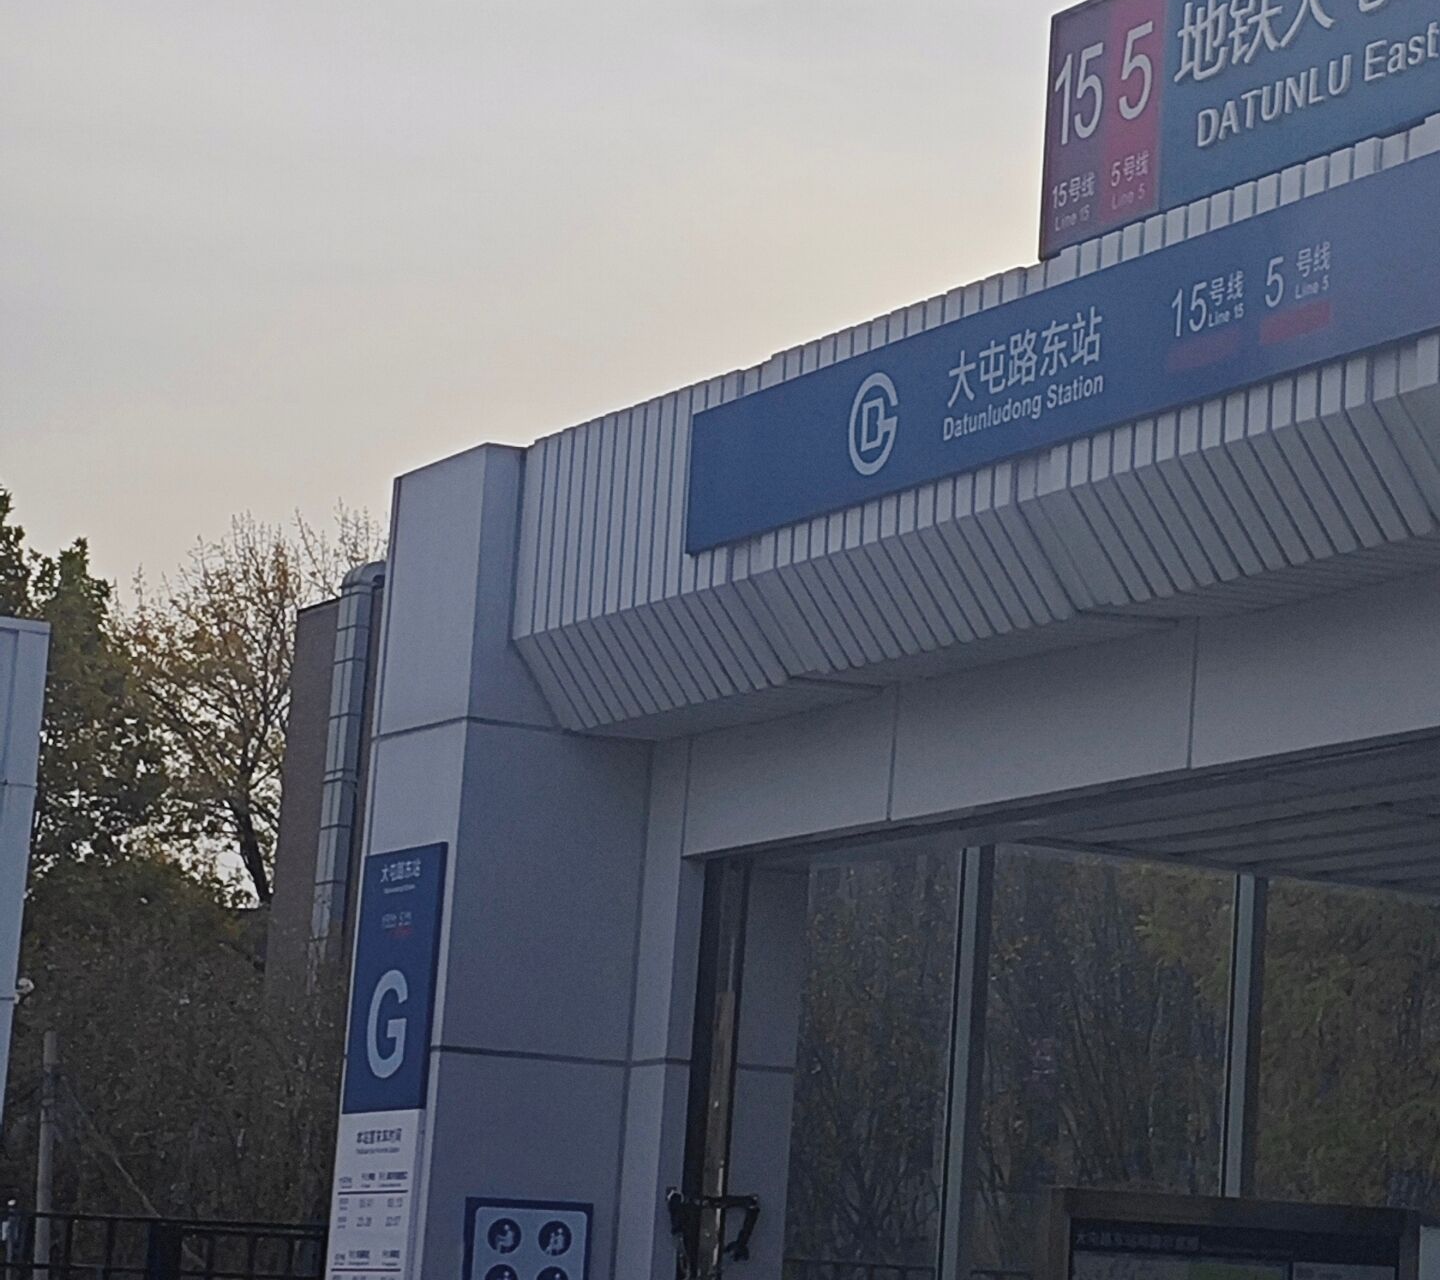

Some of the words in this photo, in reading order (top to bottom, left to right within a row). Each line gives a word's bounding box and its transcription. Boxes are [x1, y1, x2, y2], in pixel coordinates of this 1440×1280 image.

[1053, 42, 1105, 146] 15
[1118, 20, 1154, 121] 5
[1197, 54, 1352, 148] DATUNLU
[1364, 22, 1440, 83] East
[1052, 172, 1095, 209] 15号线
[1111, 150, 1149, 187] 5号线
[1265, 256, 1285, 308] 5
[947, 306, 1103, 408] 大屯路东站
[943, 394, 1042, 442] Datunludong
[1046, 374, 1104, 410] Station
[366, 969, 409, 1079] G
